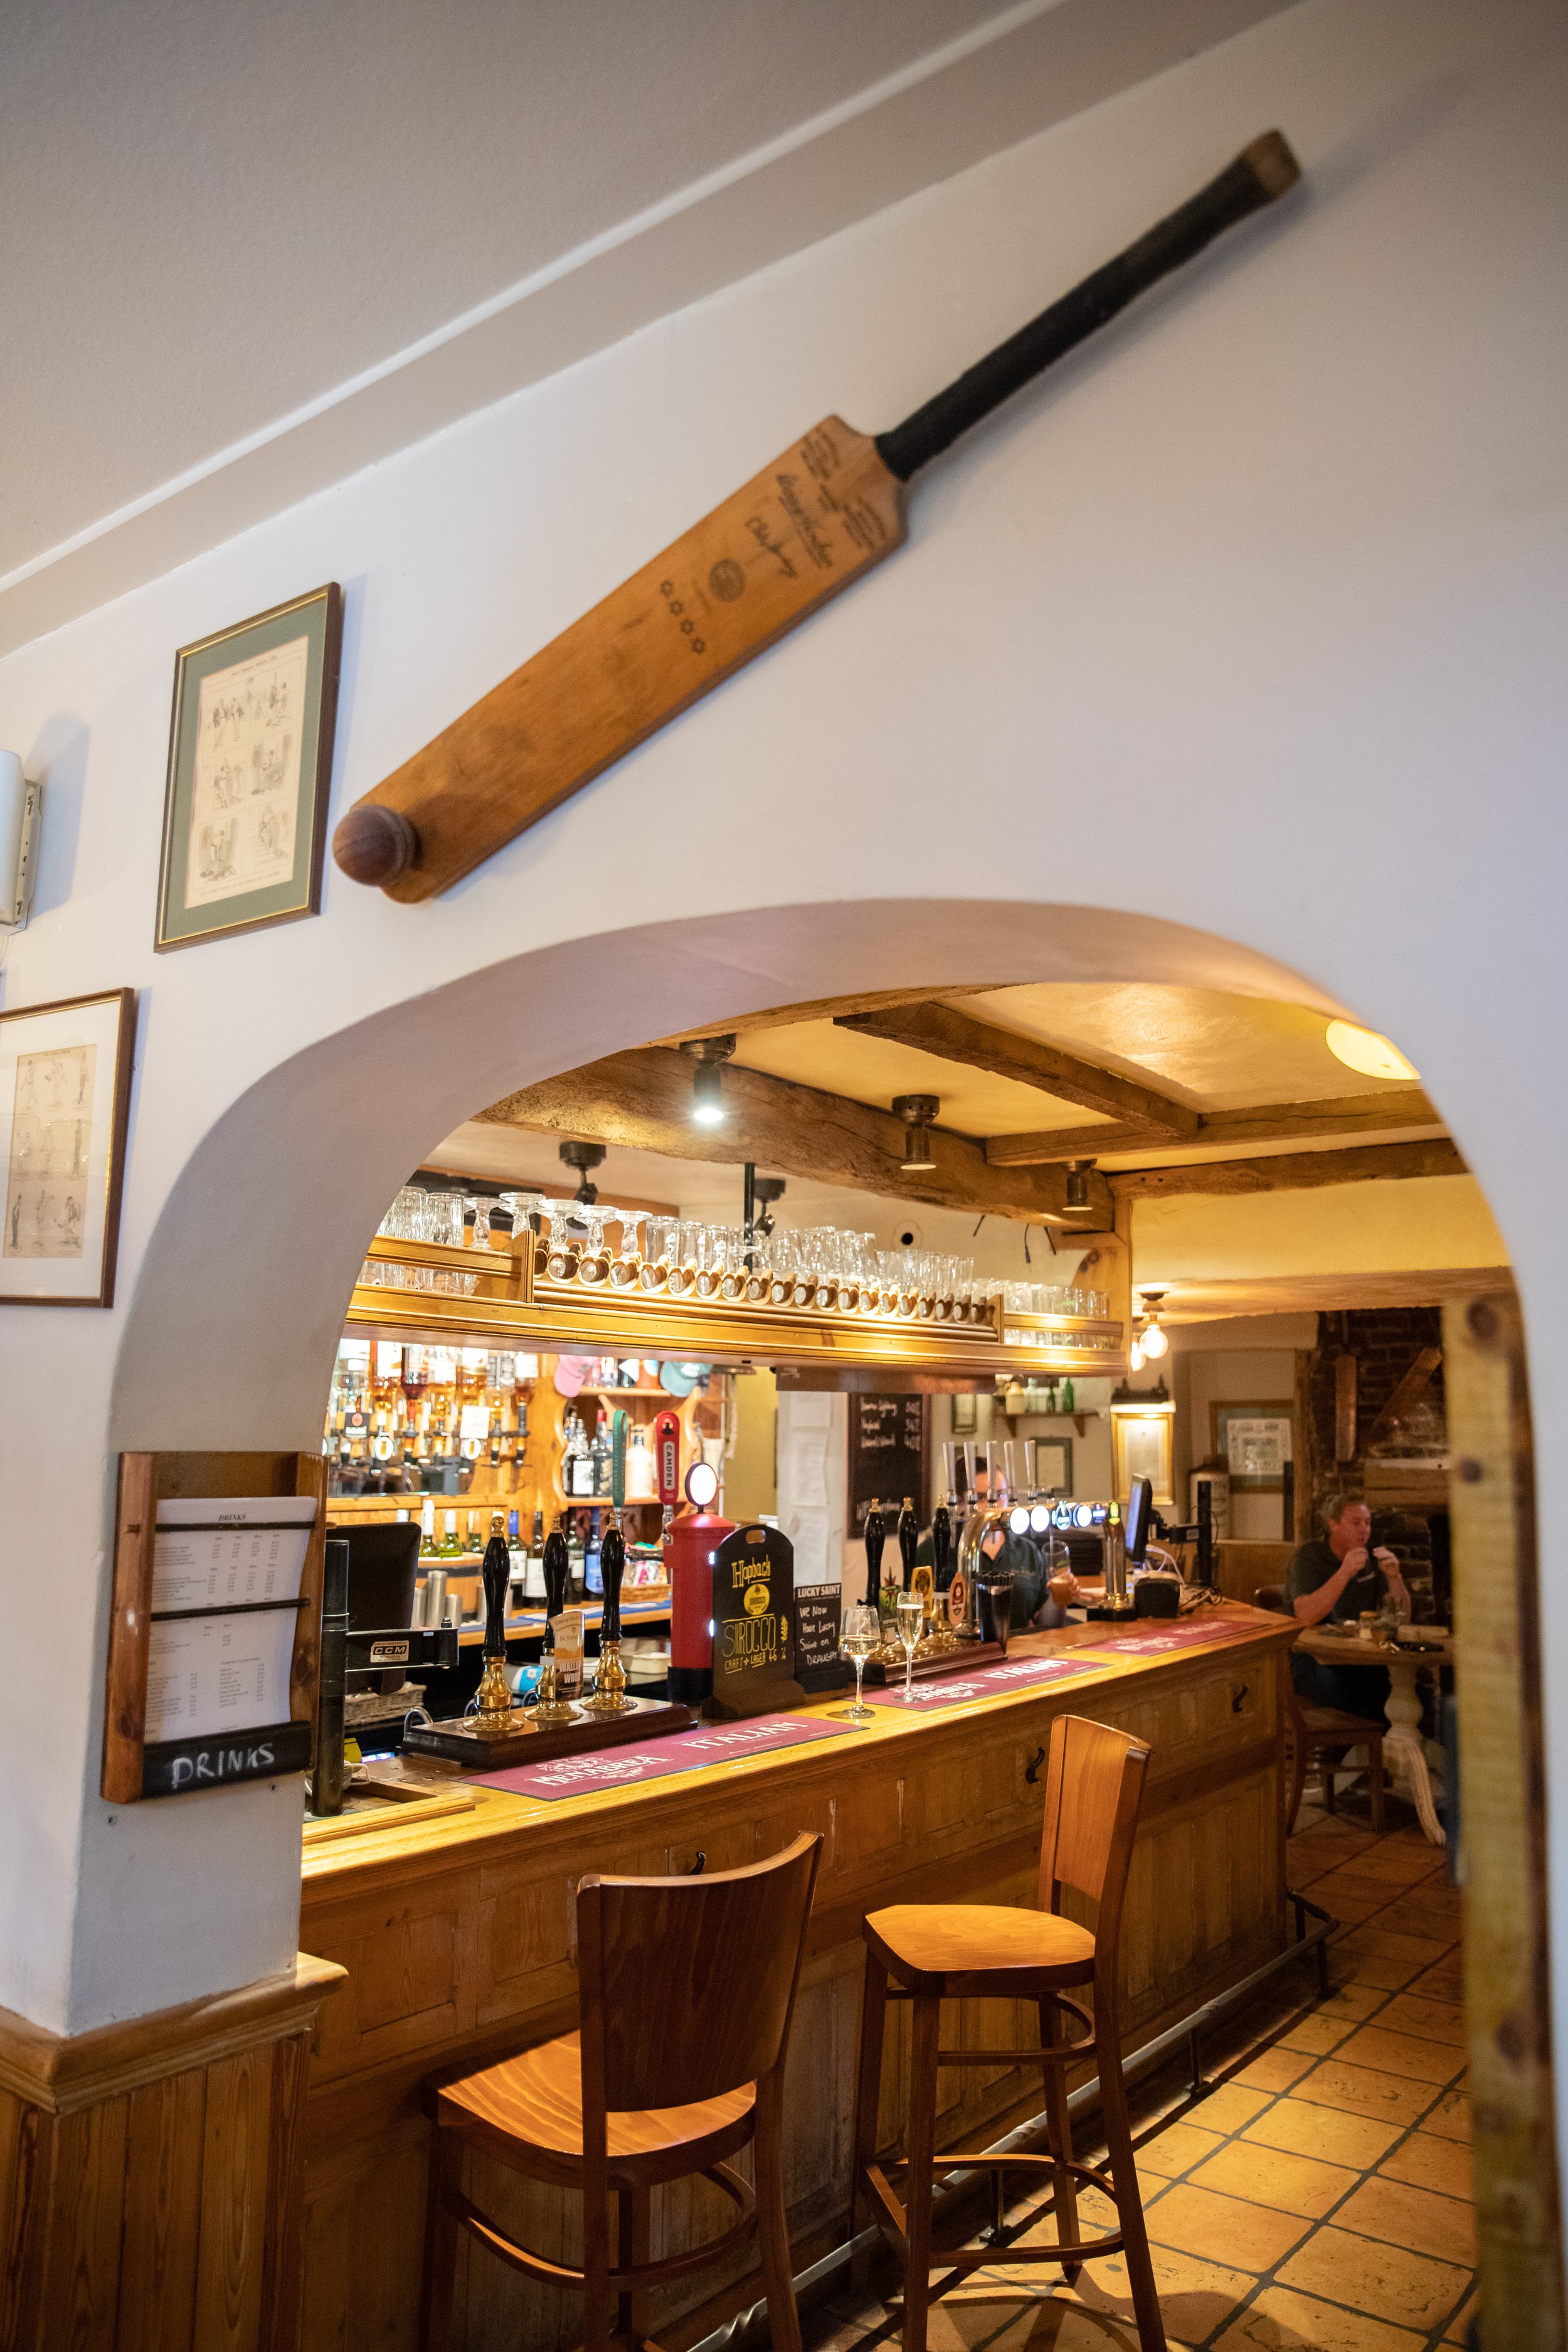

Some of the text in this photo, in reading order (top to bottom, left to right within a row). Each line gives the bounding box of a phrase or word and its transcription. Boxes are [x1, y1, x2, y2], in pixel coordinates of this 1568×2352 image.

[731, 1554, 771, 1588] Hopback
[797, 1586, 820, 1599] LUCKY
[820, 1584, 840, 1596] SAINT
[721, 1616, 776, 1658] SIROCCO
[802, 1620, 836, 1638] Have Lucky
[374, 1646, 406, 1655] CCM
[799, 1638, 830, 1651] Saint on
[724, 1656, 744, 1671] CRAFT
[750, 1651, 766, 1665] LAGER
[682, 1722, 809, 1750] ITALIAN
[171, 1743, 275, 1788] DRINKS
[529, 1755, 670, 1786] MENABREA
